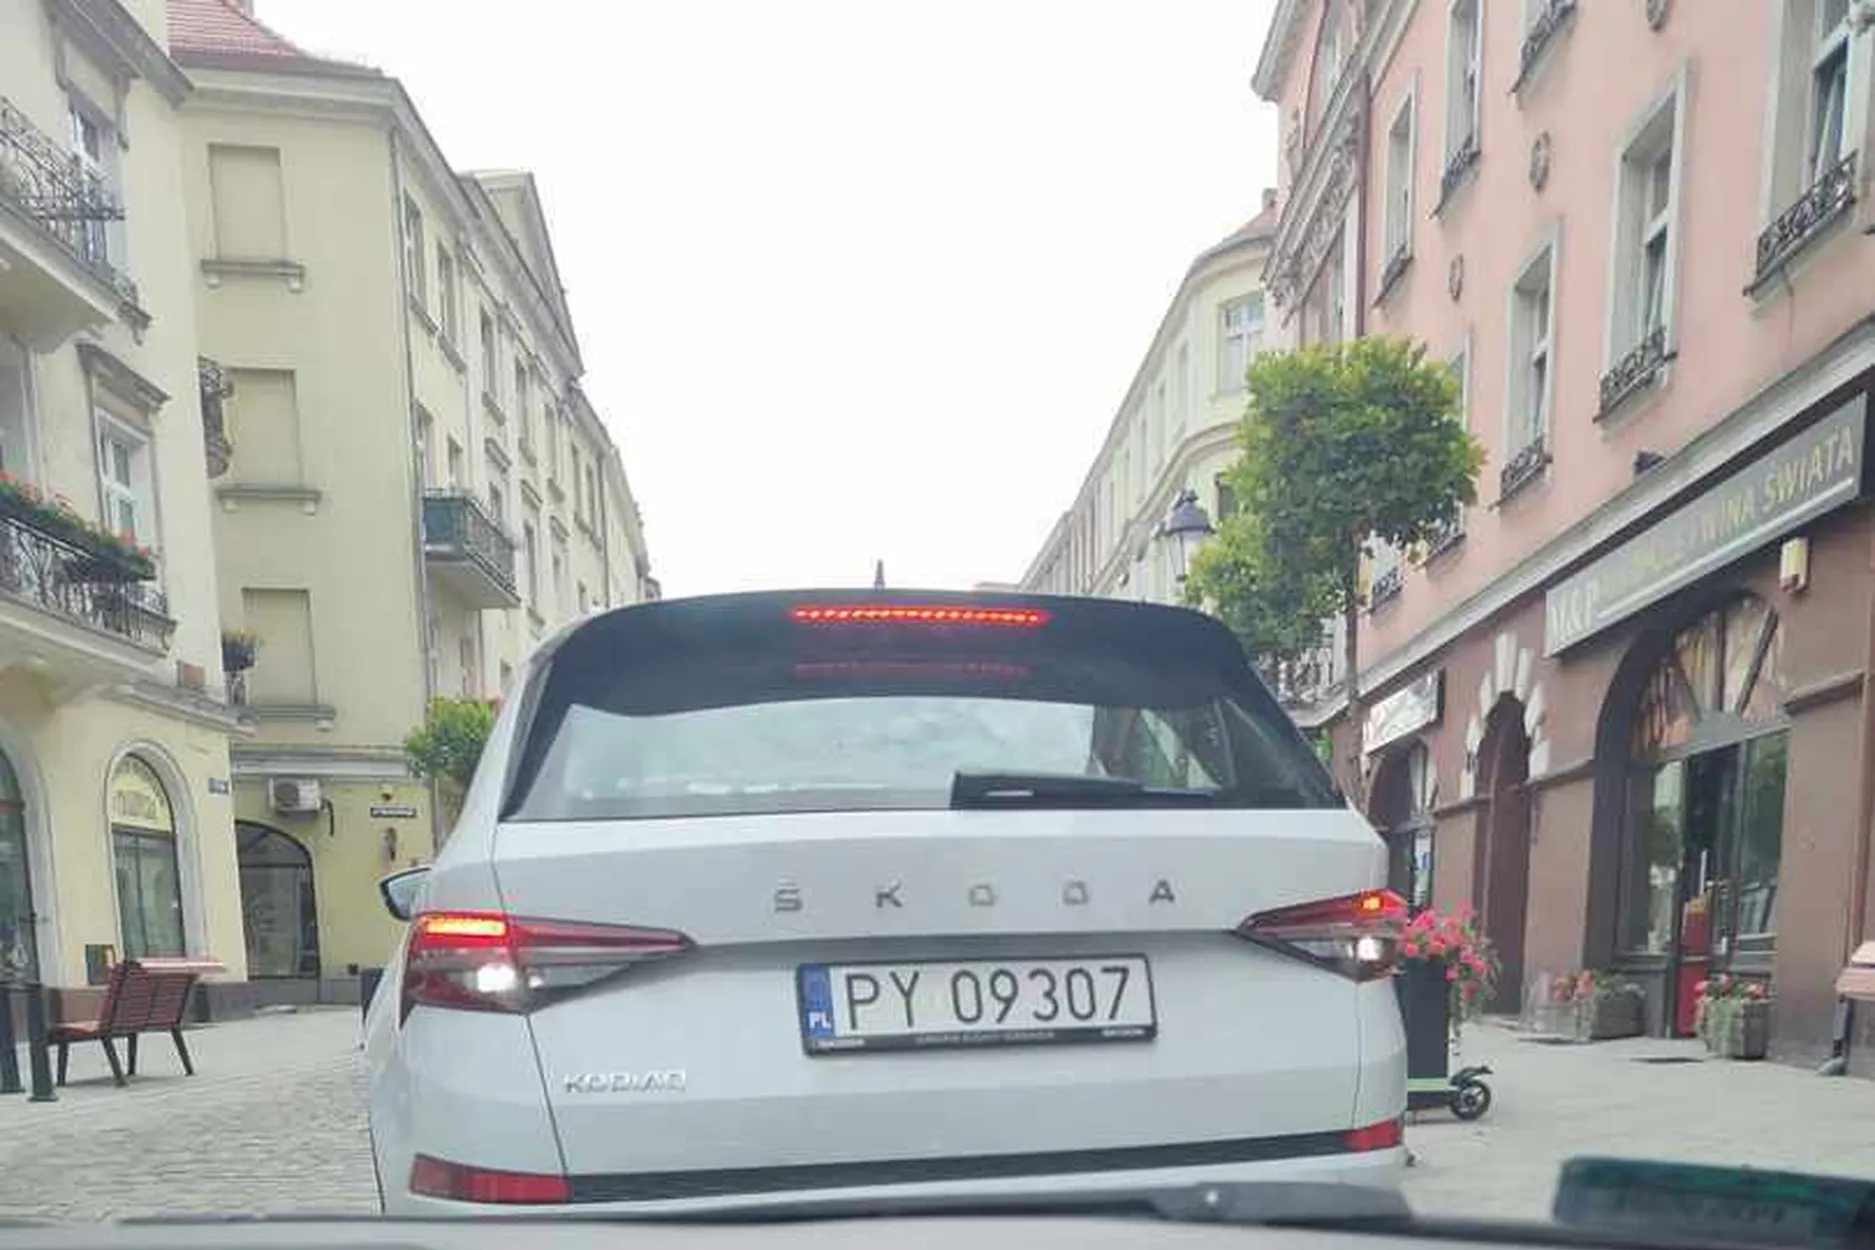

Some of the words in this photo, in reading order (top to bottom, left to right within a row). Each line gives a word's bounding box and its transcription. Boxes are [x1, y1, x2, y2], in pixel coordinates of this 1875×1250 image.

[845, 970, 920, 1030] PY
[950, 966, 1130, 1024] 09307
[808, 1012, 831, 1030] PL
